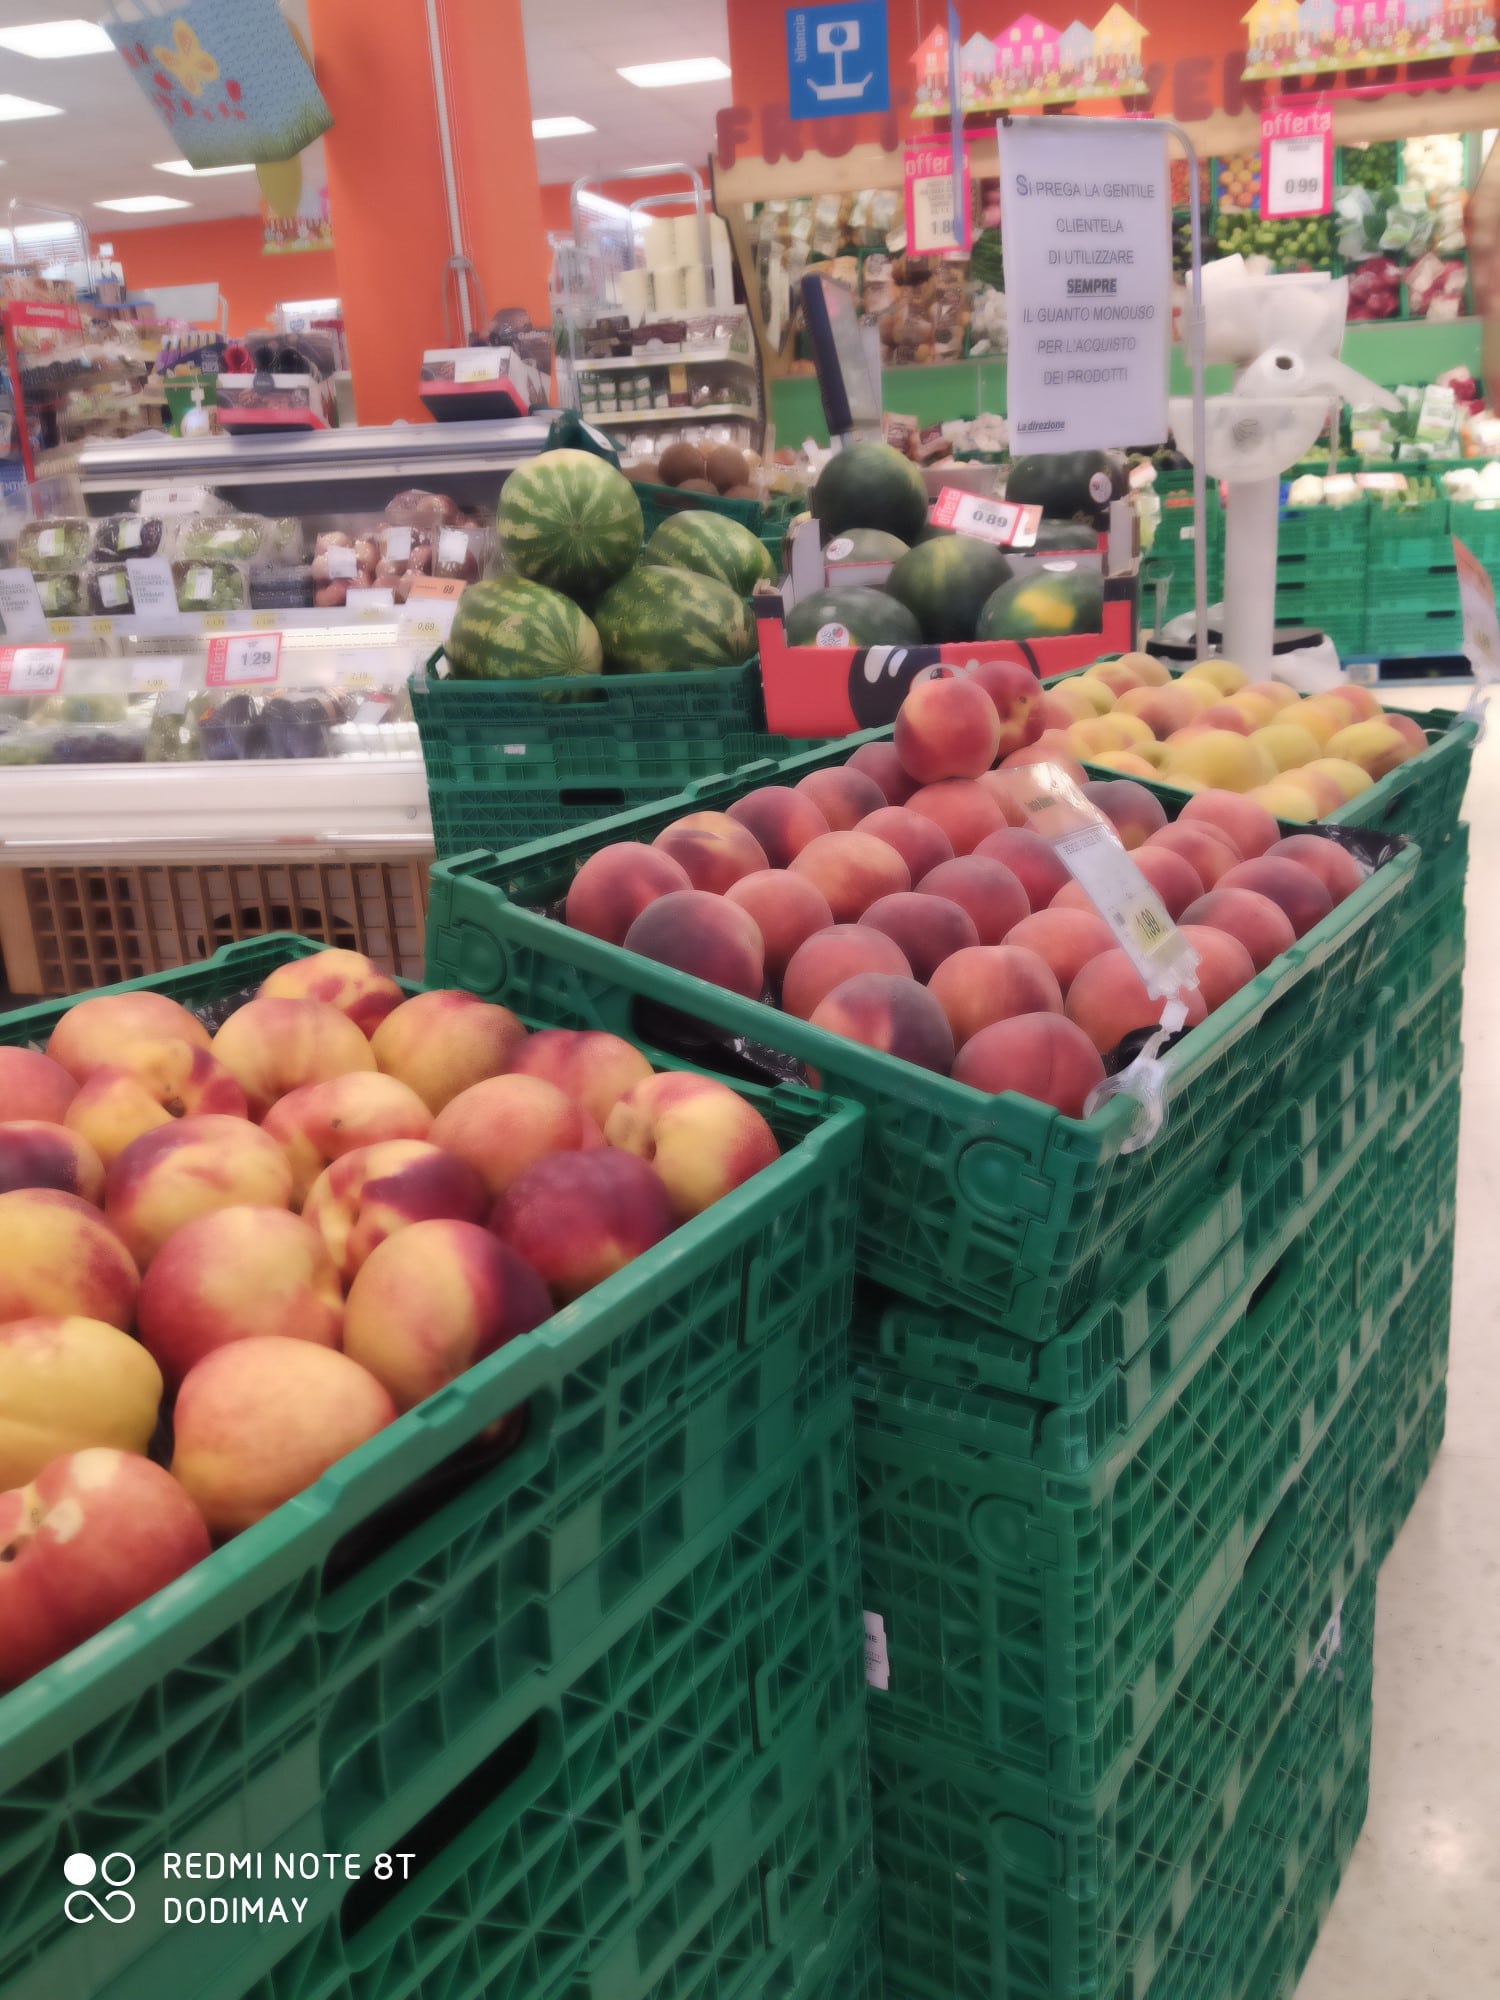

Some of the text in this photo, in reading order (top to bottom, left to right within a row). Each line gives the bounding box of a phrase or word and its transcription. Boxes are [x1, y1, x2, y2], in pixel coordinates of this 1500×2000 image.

[795, 14, 807, 62] bilancia
[1262, 111, 1332, 138] offerta
[1036, 182, 1082, 196] PREGA
[1085, 183, 1099, 197] LA
[1103, 183, 1155, 198] GENTILE
[1056, 217, 1125, 233] CLIENTELA
[1048, 249, 1134, 265] DI UTILIZZARE
[1066, 278, 1118, 294] SEMPRE
[1023, 304, 1155, 323] IL GUANTO MONOUSO
[1038, 336, 1137, 354] PER L'ACQUISTO
[1043, 367, 1128, 385] DEI PRODOTTI
[1017, 420, 1066, 432] La direzione
